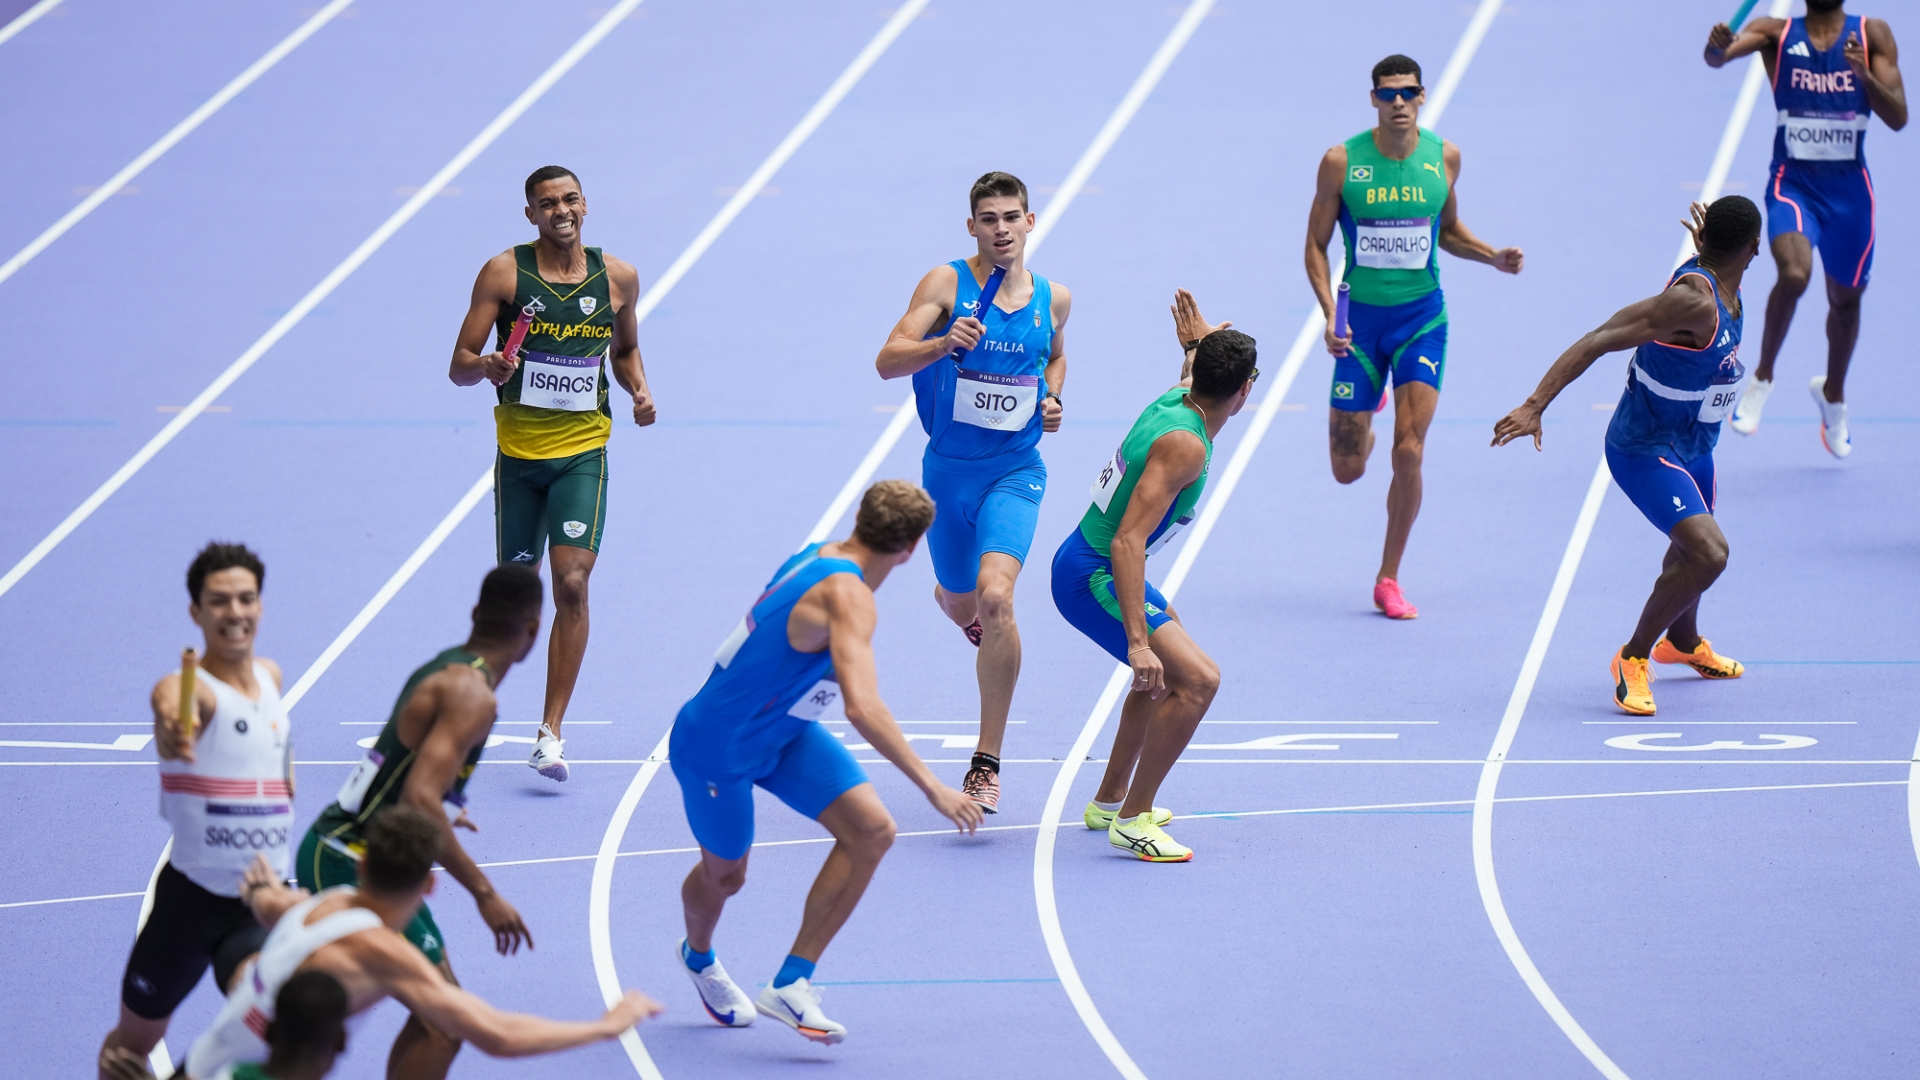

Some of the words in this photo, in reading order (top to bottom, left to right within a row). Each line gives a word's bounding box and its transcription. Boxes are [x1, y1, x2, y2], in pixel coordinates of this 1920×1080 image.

[1791, 68, 1855, 93] FRANCE
[1788, 127, 1854, 144] KOUNTA
[1366, 186, 1427, 205] BRASIL
[1359, 236, 1430, 253] CARVALHO
[561, 324, 612, 338] AFRICA
[984, 340, 1025, 353] ITALIA
[545, 356, 566, 364] PARIS
[530, 371, 594, 394] ISAACS
[979, 374, 1000, 382] PARIS
[974, 392, 1018, 412] SITO
